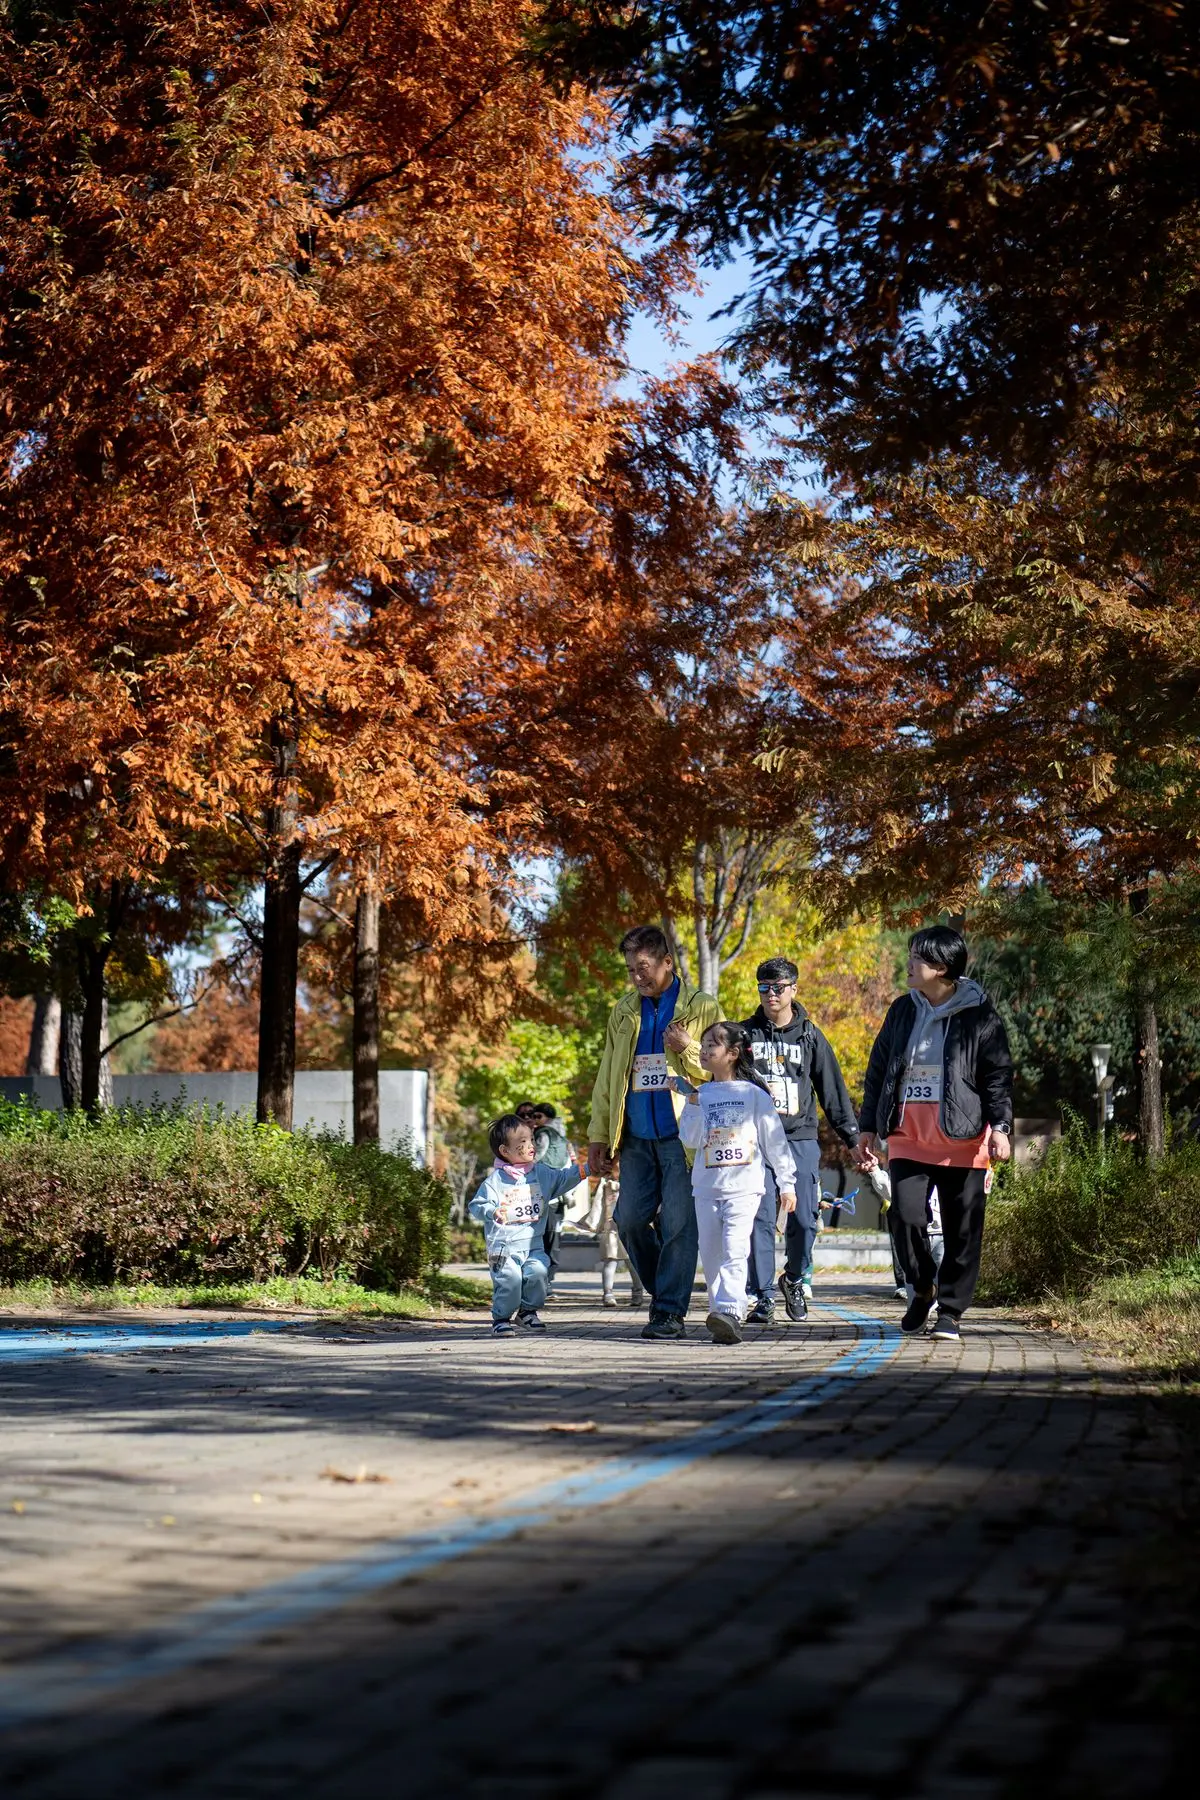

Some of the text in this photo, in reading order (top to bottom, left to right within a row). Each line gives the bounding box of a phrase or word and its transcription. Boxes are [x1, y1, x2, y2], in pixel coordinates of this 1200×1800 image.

[642, 1074, 667, 1086] 387
[905, 1086, 932, 1098] 033
[715, 1148, 743, 1161] 385
[515, 1203, 540, 1217] 386
